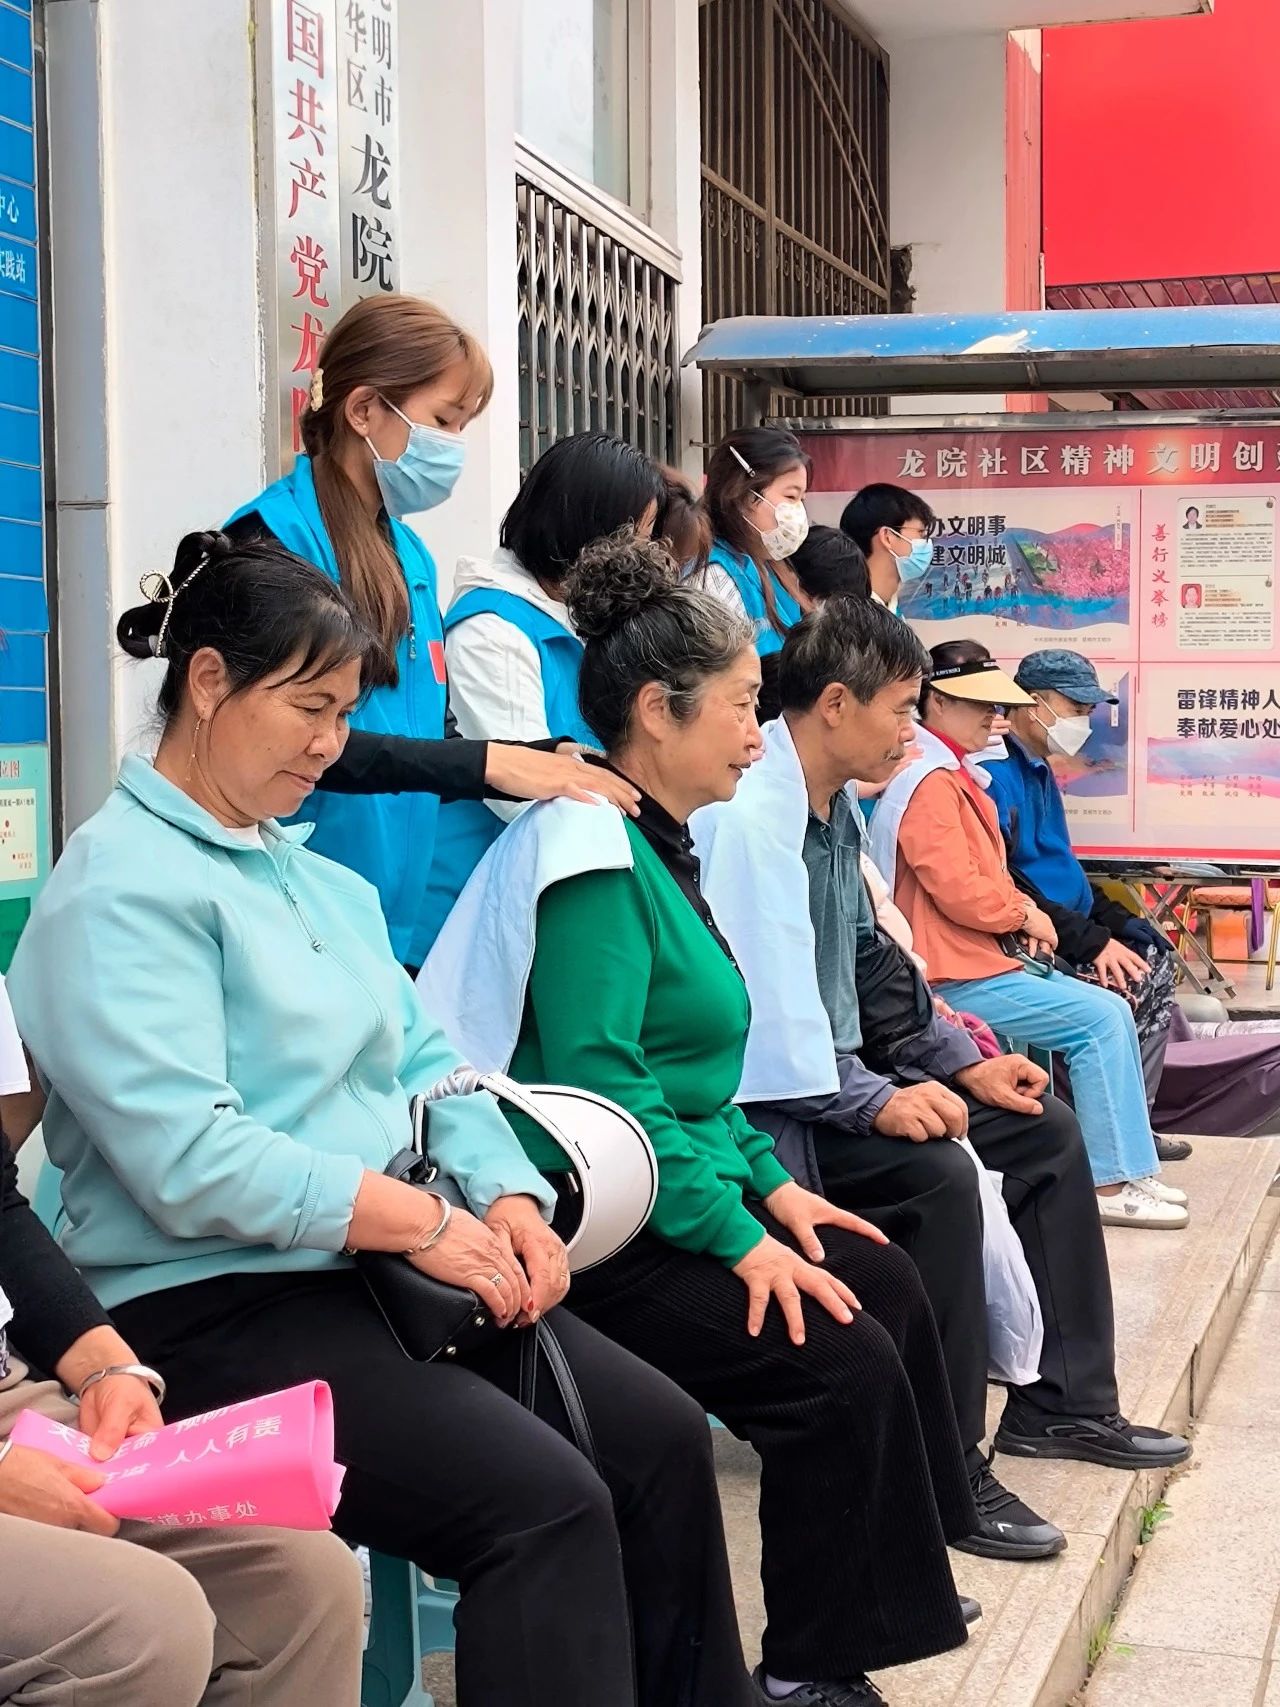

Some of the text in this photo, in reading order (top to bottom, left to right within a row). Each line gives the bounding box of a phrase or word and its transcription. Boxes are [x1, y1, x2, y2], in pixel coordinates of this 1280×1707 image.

[350, 134, 394, 300] 龙院
[897, 440, 1280, 479] 龙院社区精神文明创
[1177, 688, 1280, 711] 雷锋精神人
[1176, 717, 1280, 740] 奉献爱心处
[166, 1416, 282, 1468] 人人有责
